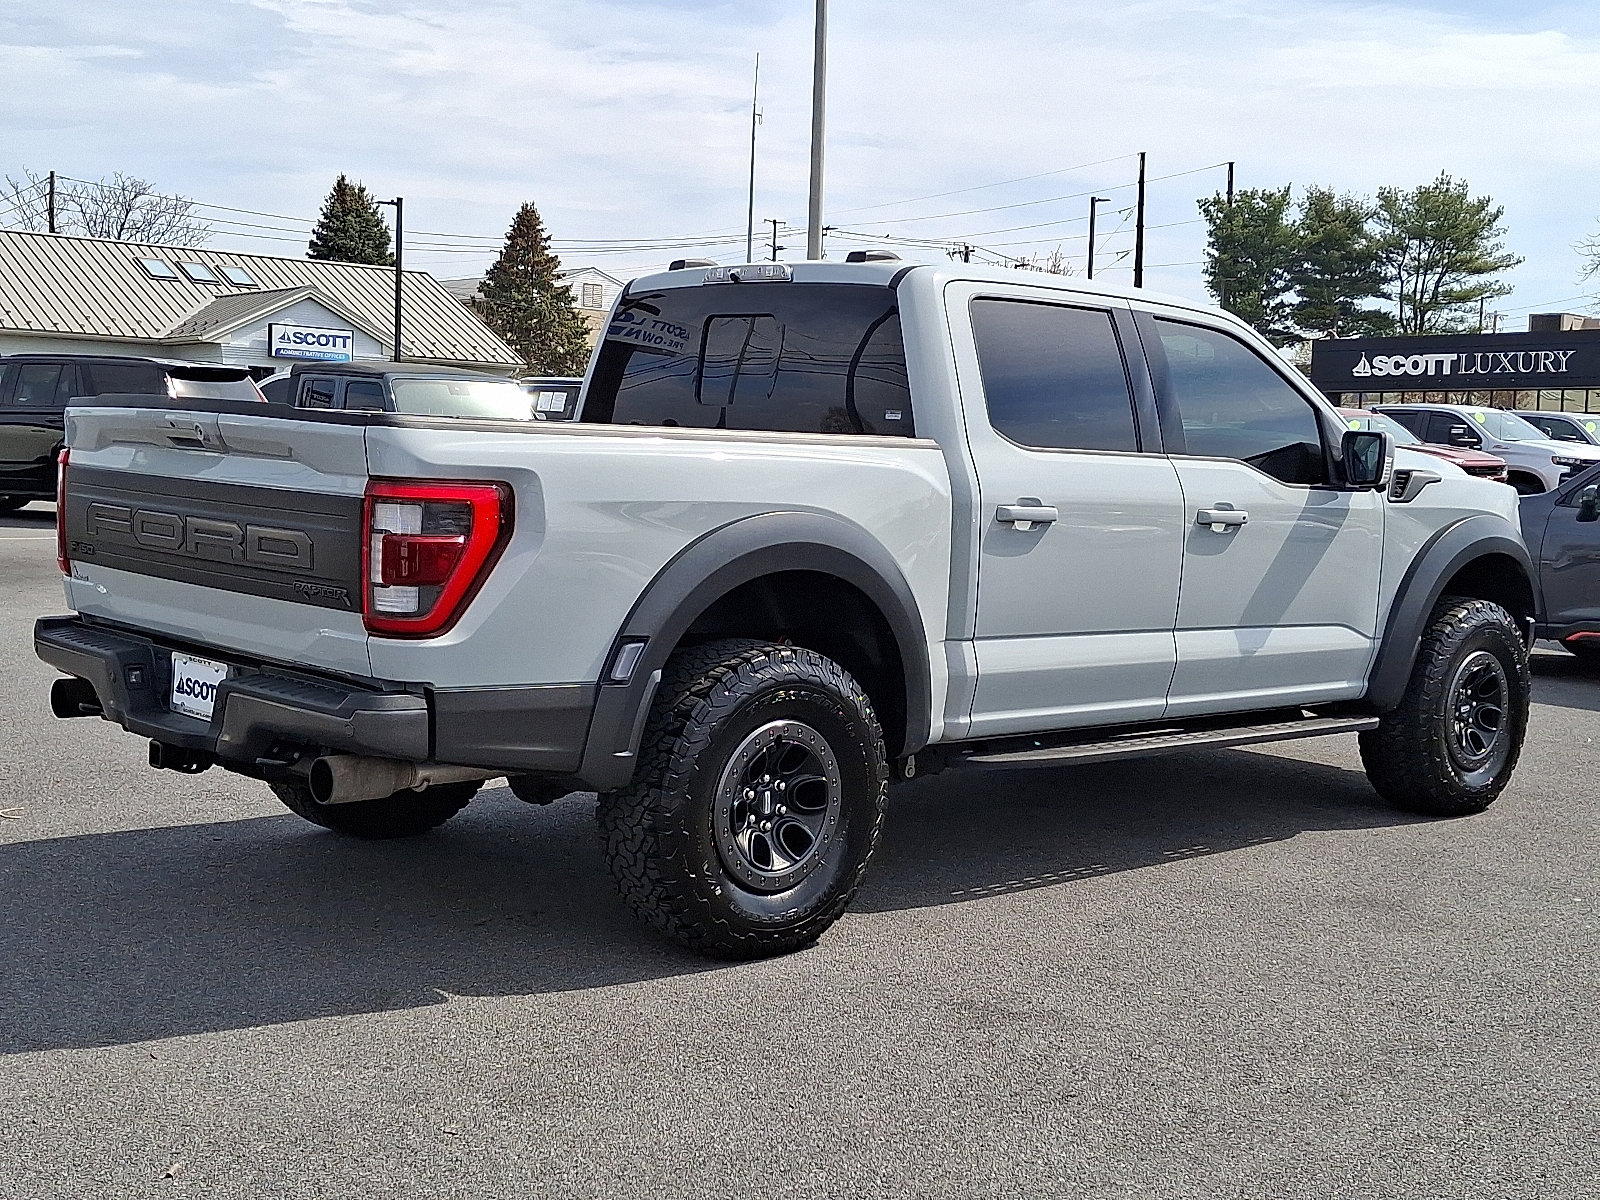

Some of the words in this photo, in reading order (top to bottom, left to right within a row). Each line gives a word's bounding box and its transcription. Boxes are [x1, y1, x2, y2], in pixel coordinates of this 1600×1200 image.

[292, 332, 351, 348] SCOTT
[280, 349, 323, 357] ADMINISTRATIVE
[1372, 353, 1457, 376] SCOTT
[1457, 350, 1577, 374] LUXURY
[86, 501, 314, 570] FORD
[293, 579, 352, 607] RAPTOR
[189, 657, 211, 666] SCOTT
[185, 677, 216, 702] SCOT
